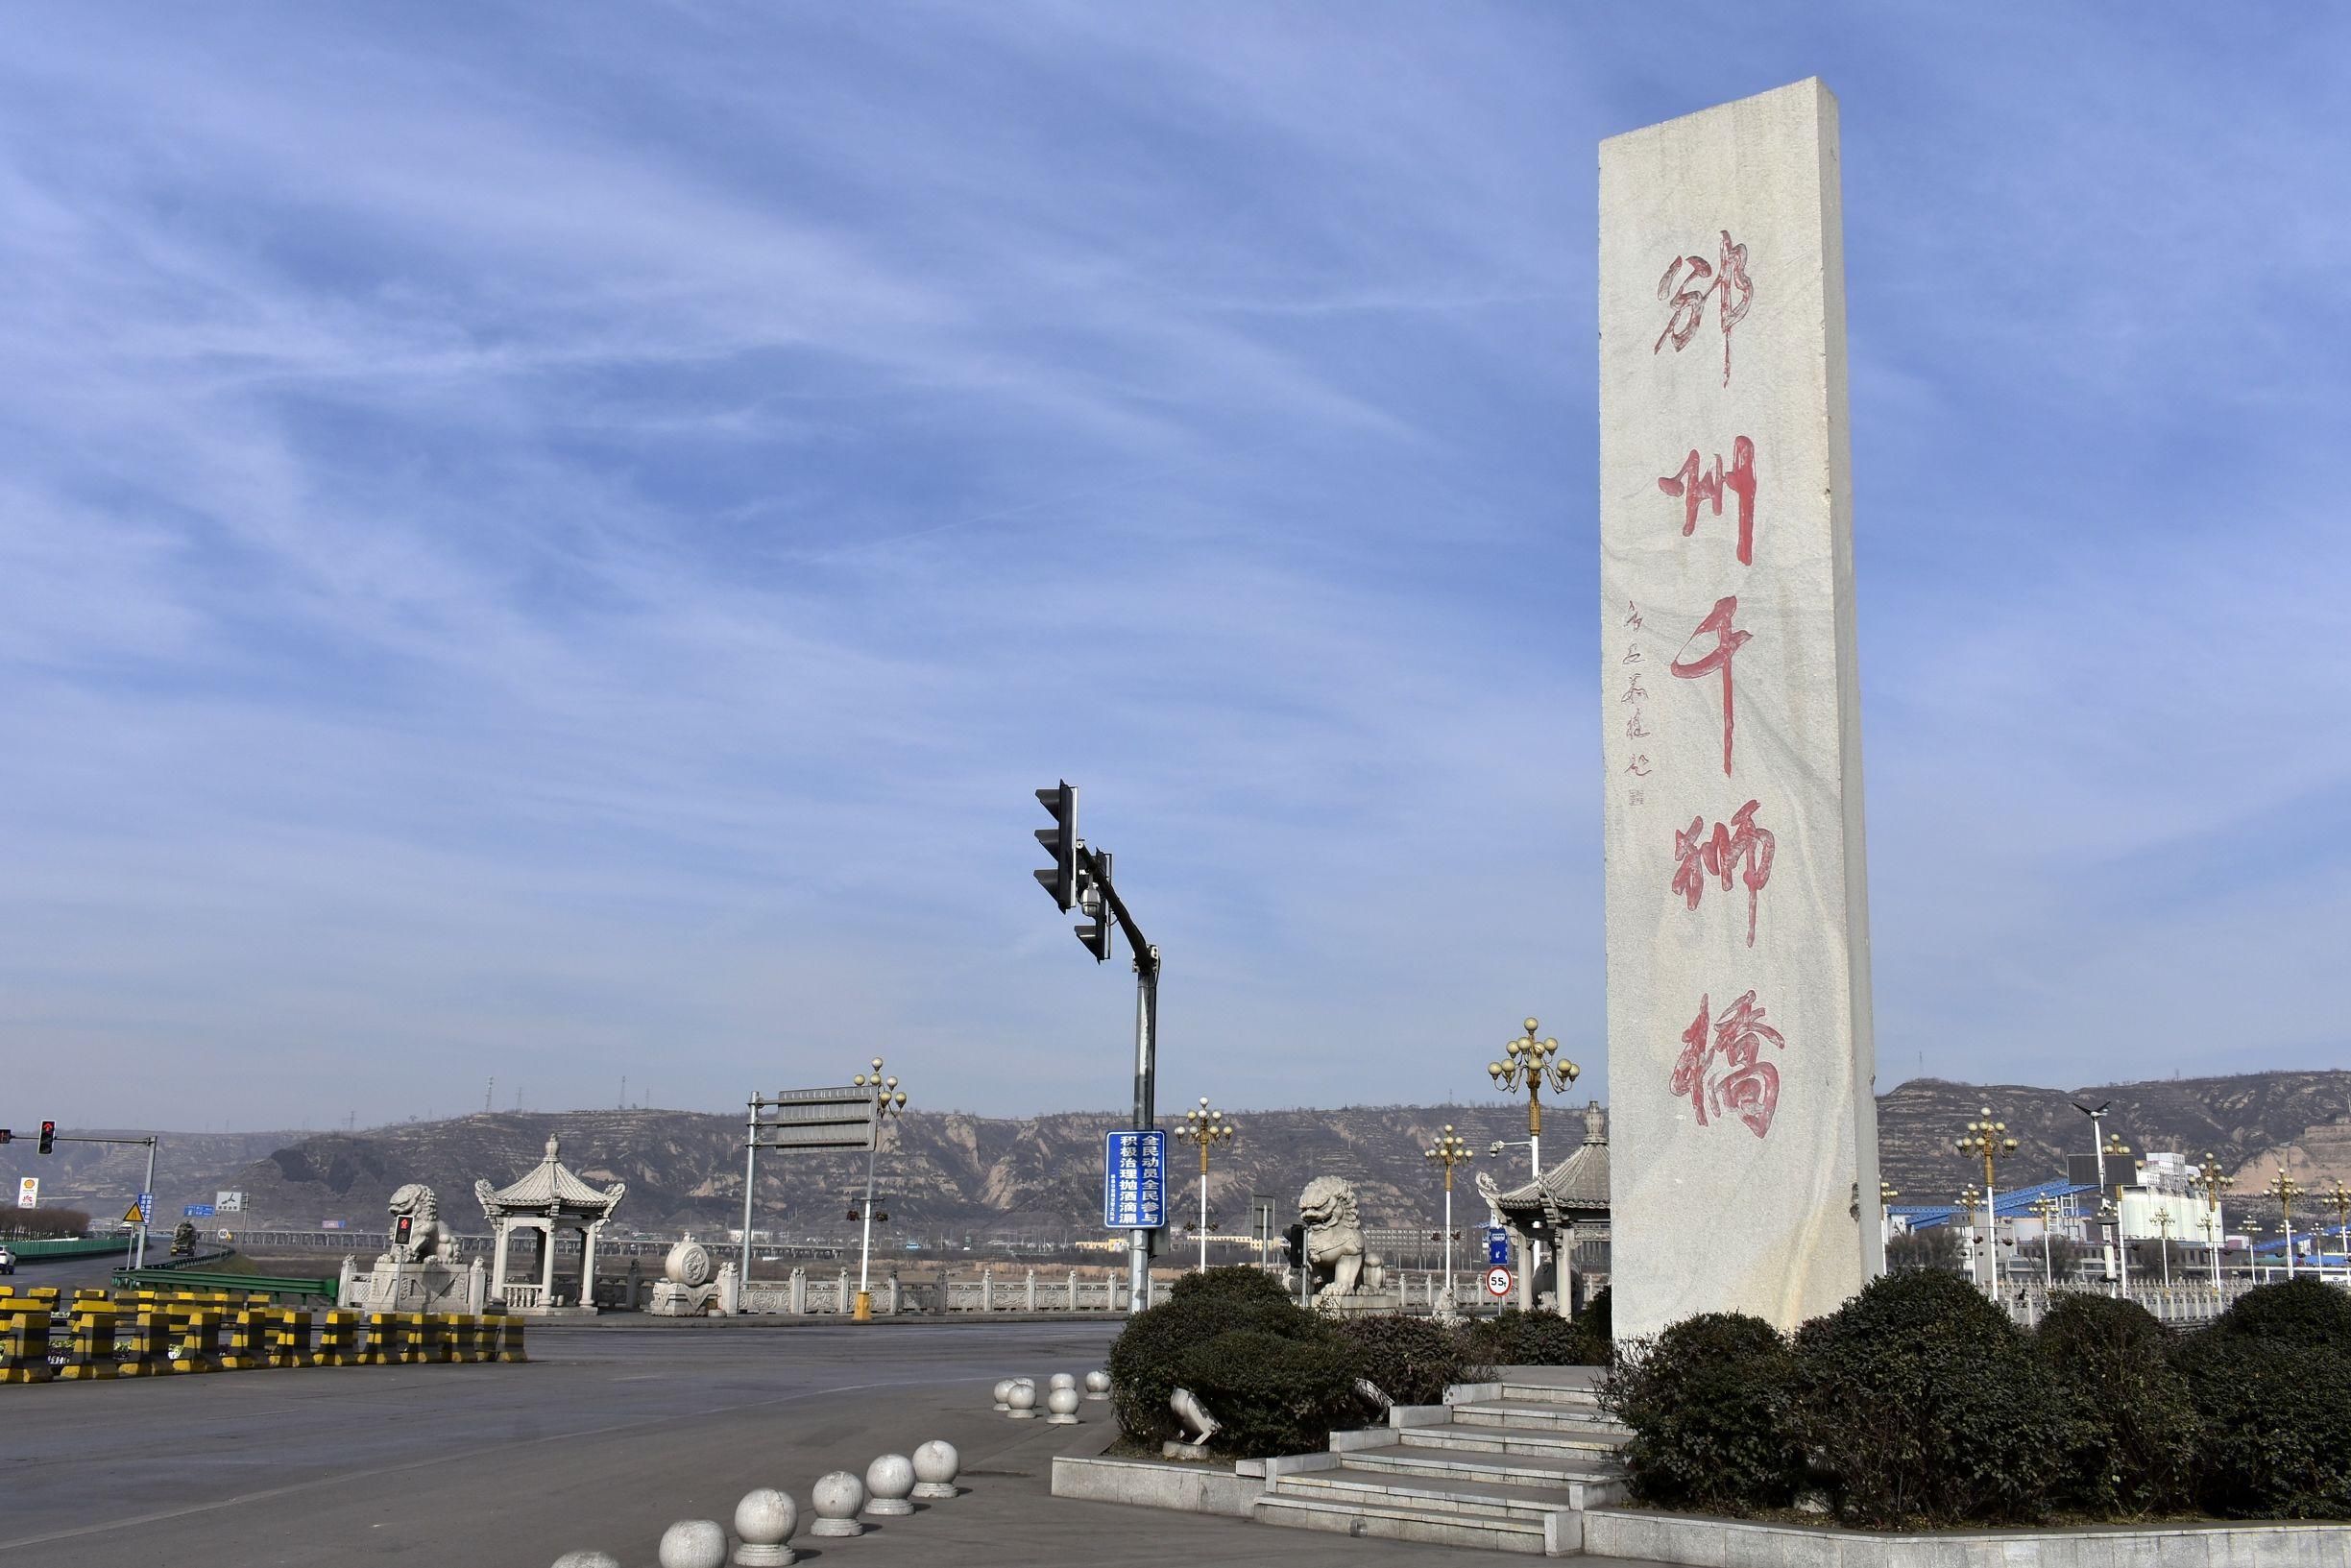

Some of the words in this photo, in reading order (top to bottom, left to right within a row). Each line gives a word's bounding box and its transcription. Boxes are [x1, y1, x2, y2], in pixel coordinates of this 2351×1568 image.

[1119, 1136, 1138, 1224] 积极治理抛洒滴漏
[1141, 1135, 1159, 1223] 全民动员全民参与
